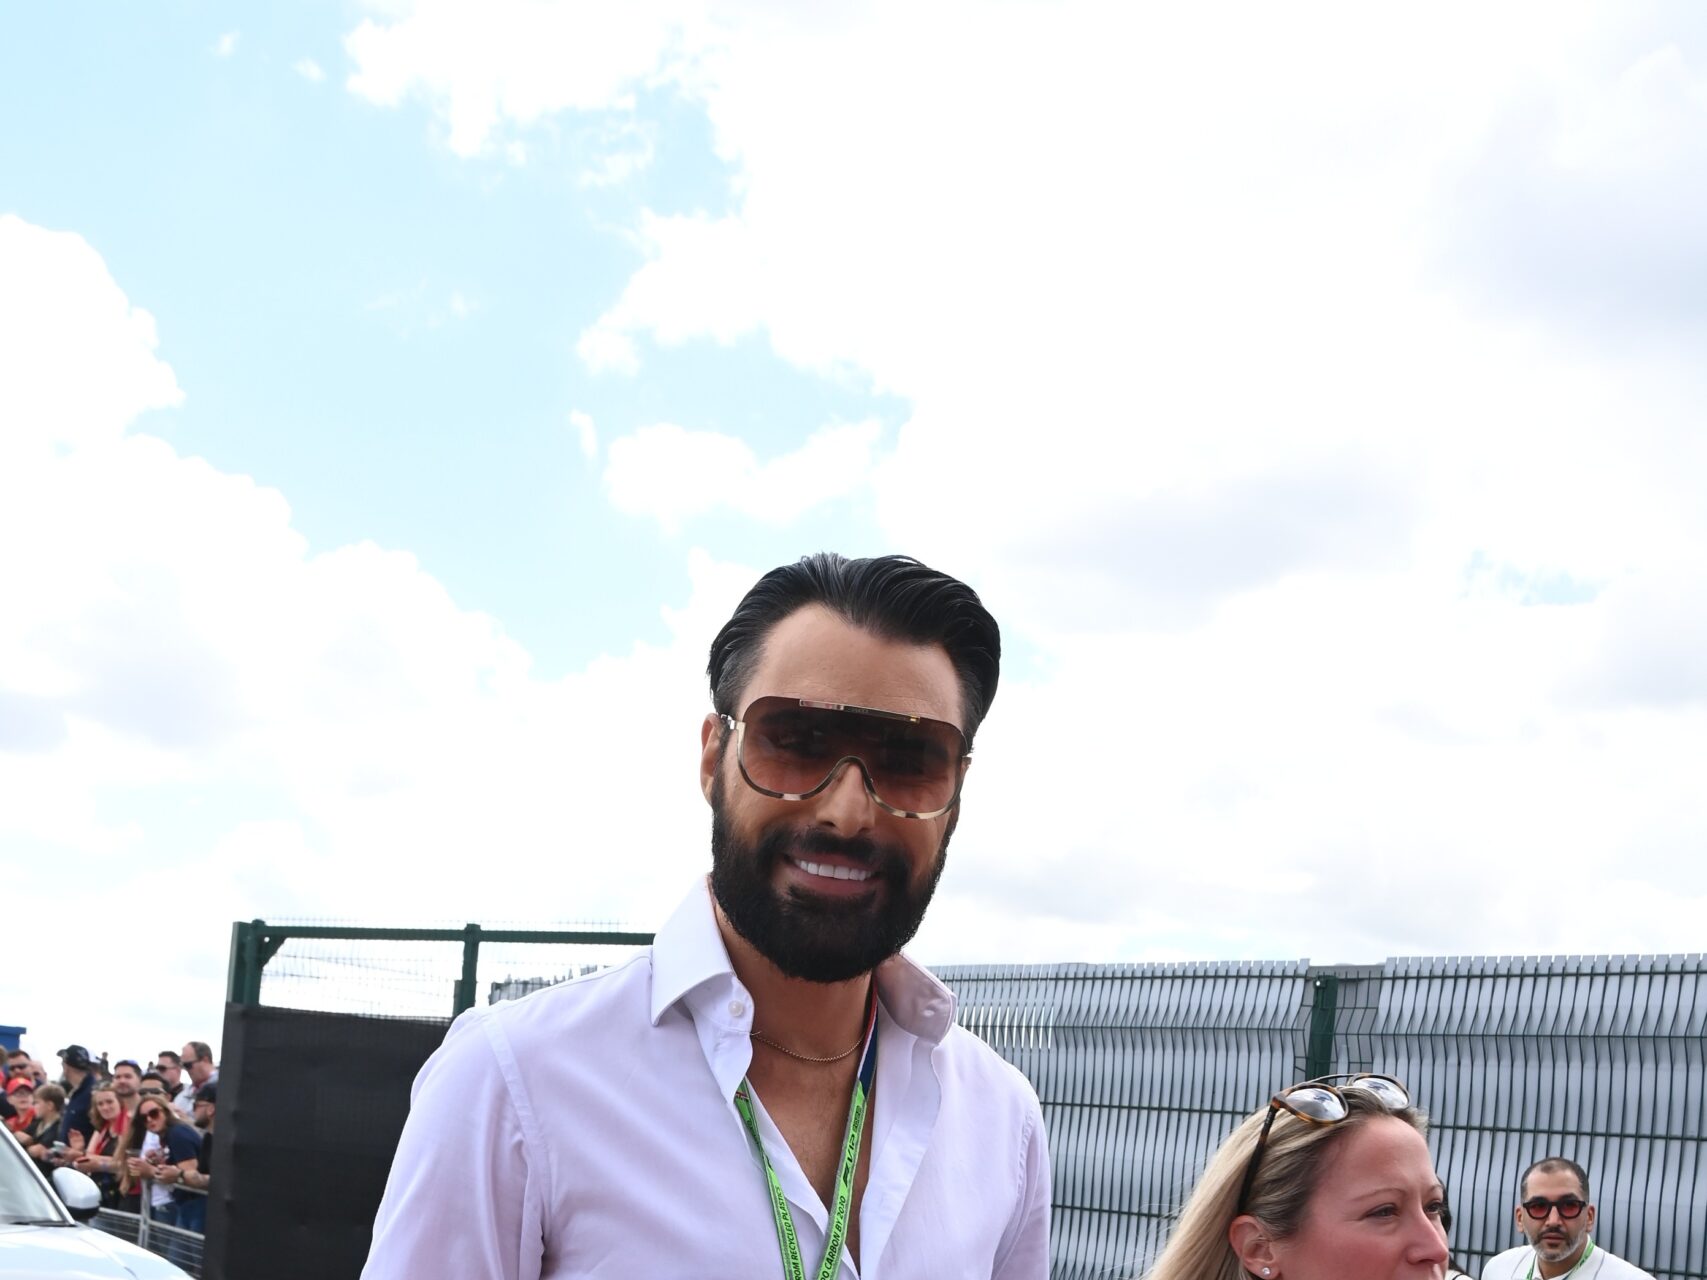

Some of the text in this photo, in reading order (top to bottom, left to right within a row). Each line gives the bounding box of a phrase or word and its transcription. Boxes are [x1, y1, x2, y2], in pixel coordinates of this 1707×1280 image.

[836, 1195, 846, 1220] 2030
[784, 1222, 799, 1260] RECYCLED
[835, 1220, 843, 1233] BY
[824, 1231, 841, 1271] CARBON
